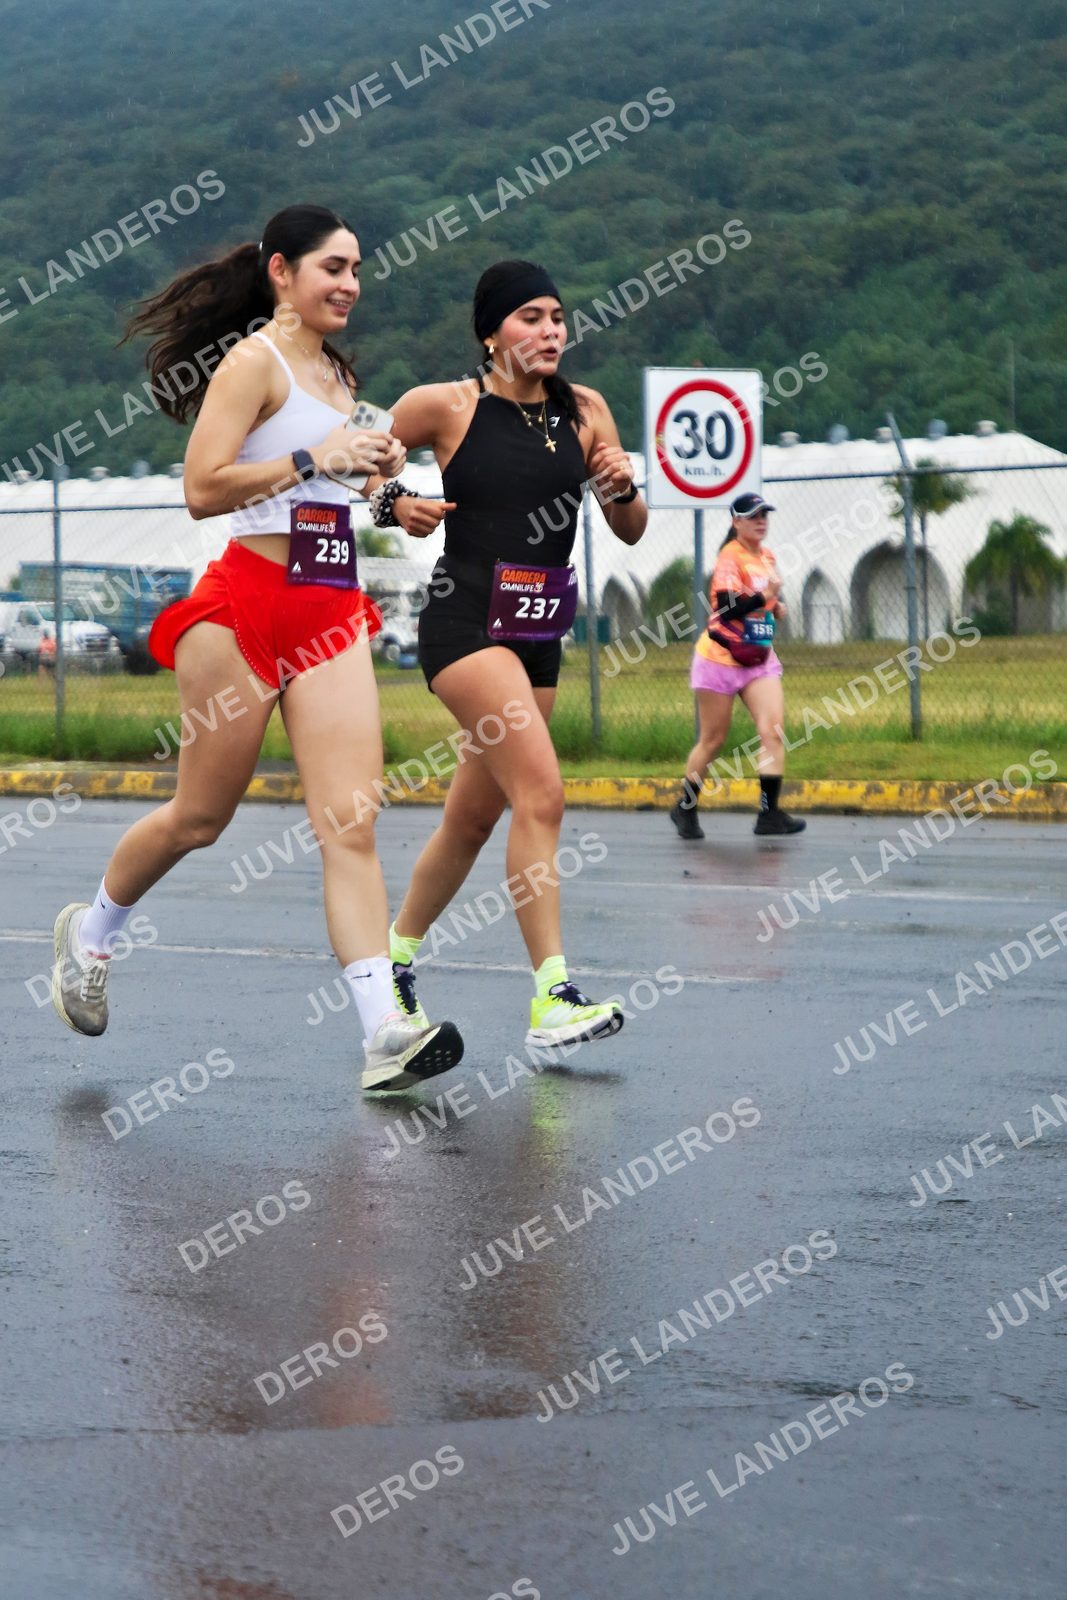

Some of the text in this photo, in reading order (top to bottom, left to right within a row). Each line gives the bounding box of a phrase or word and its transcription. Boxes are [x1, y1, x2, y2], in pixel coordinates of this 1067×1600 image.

[673, 410, 735, 460] 30
[297, 508, 337, 523] CARRERA
[315, 538, 350, 565] 239
[501, 568, 547, 583] CARRERA
[515, 597, 560, 619] 237
